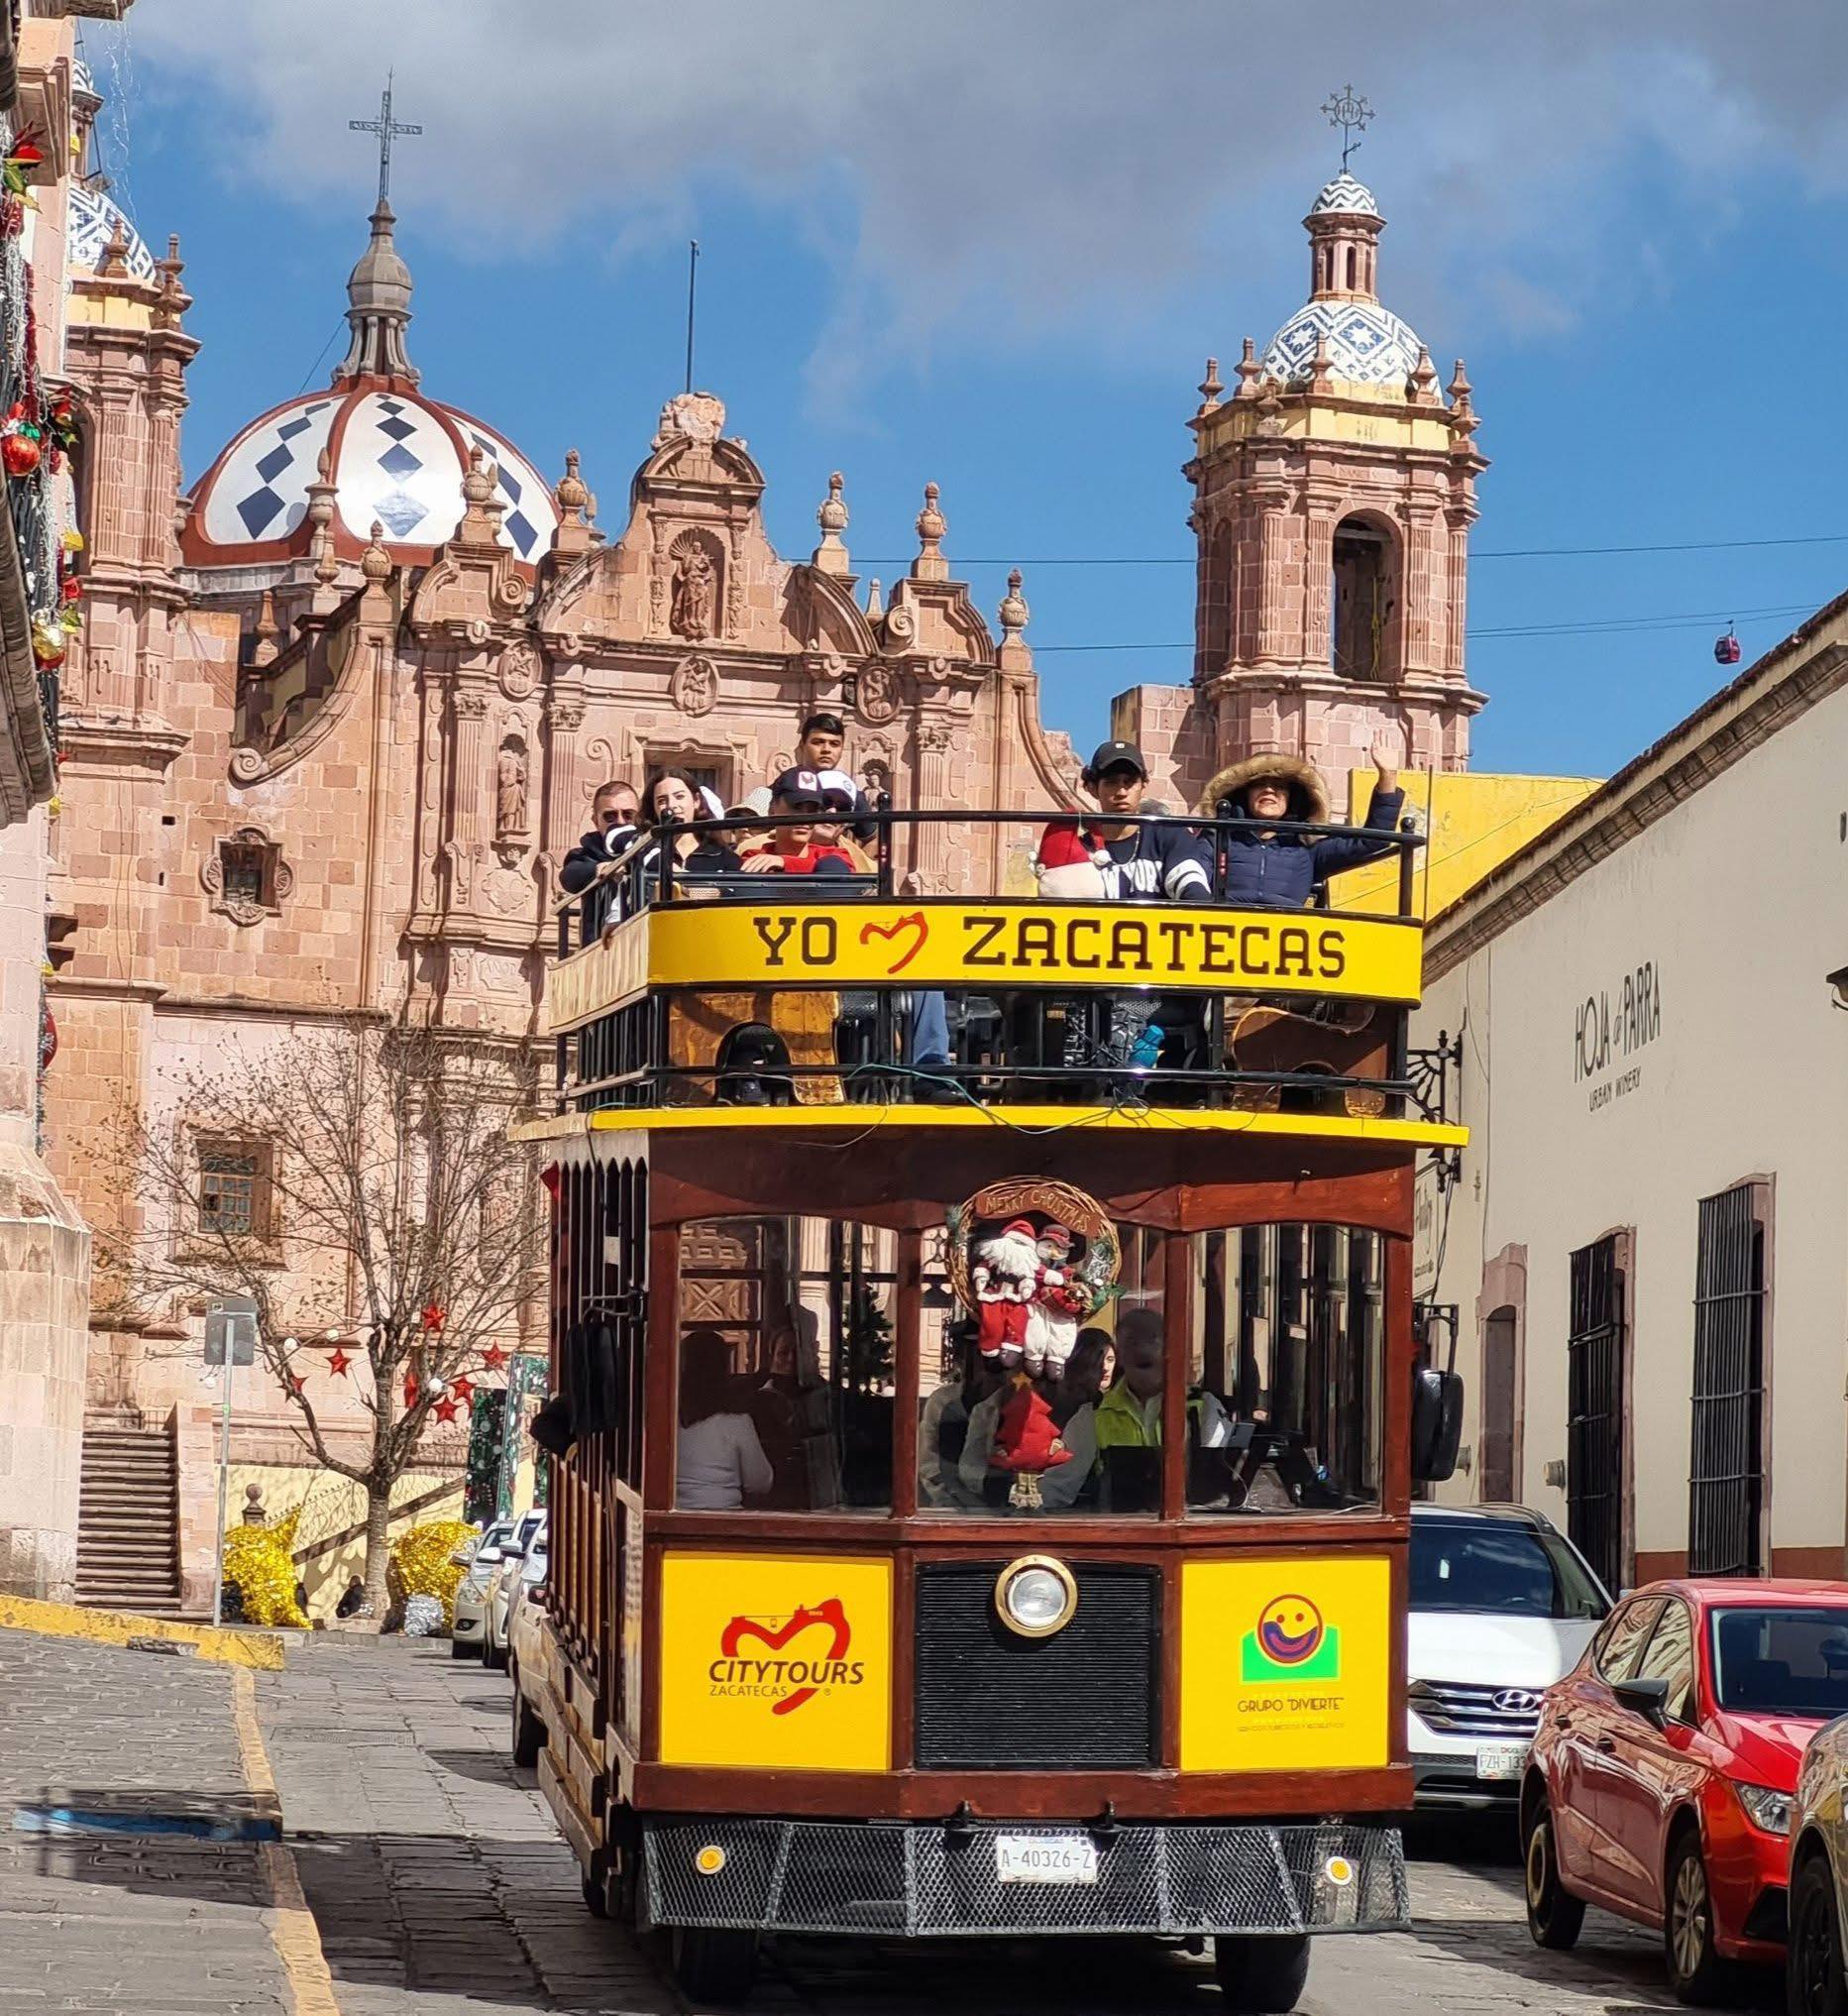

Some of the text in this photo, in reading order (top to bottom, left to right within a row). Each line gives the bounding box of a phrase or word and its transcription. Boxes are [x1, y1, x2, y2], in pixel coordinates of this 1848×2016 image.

[753, 916, 1346, 978] YO ZACATECAS
[1574, 990, 1611, 1083] HOJA
[1623, 958, 1661, 1057] PARRA
[1589, 1064, 1642, 1113] URBAN WINERY
[985, 1188, 1092, 1232] MERRY CHRISTMAS
[708, 1659, 865, 1685] CITYTOURS
[709, 1685, 788, 1697] ZACATECAS
[1237, 1696, 1346, 1713] GRUPO DIVIERTE
[1001, 1848, 1093, 1869] A-40326-Z
